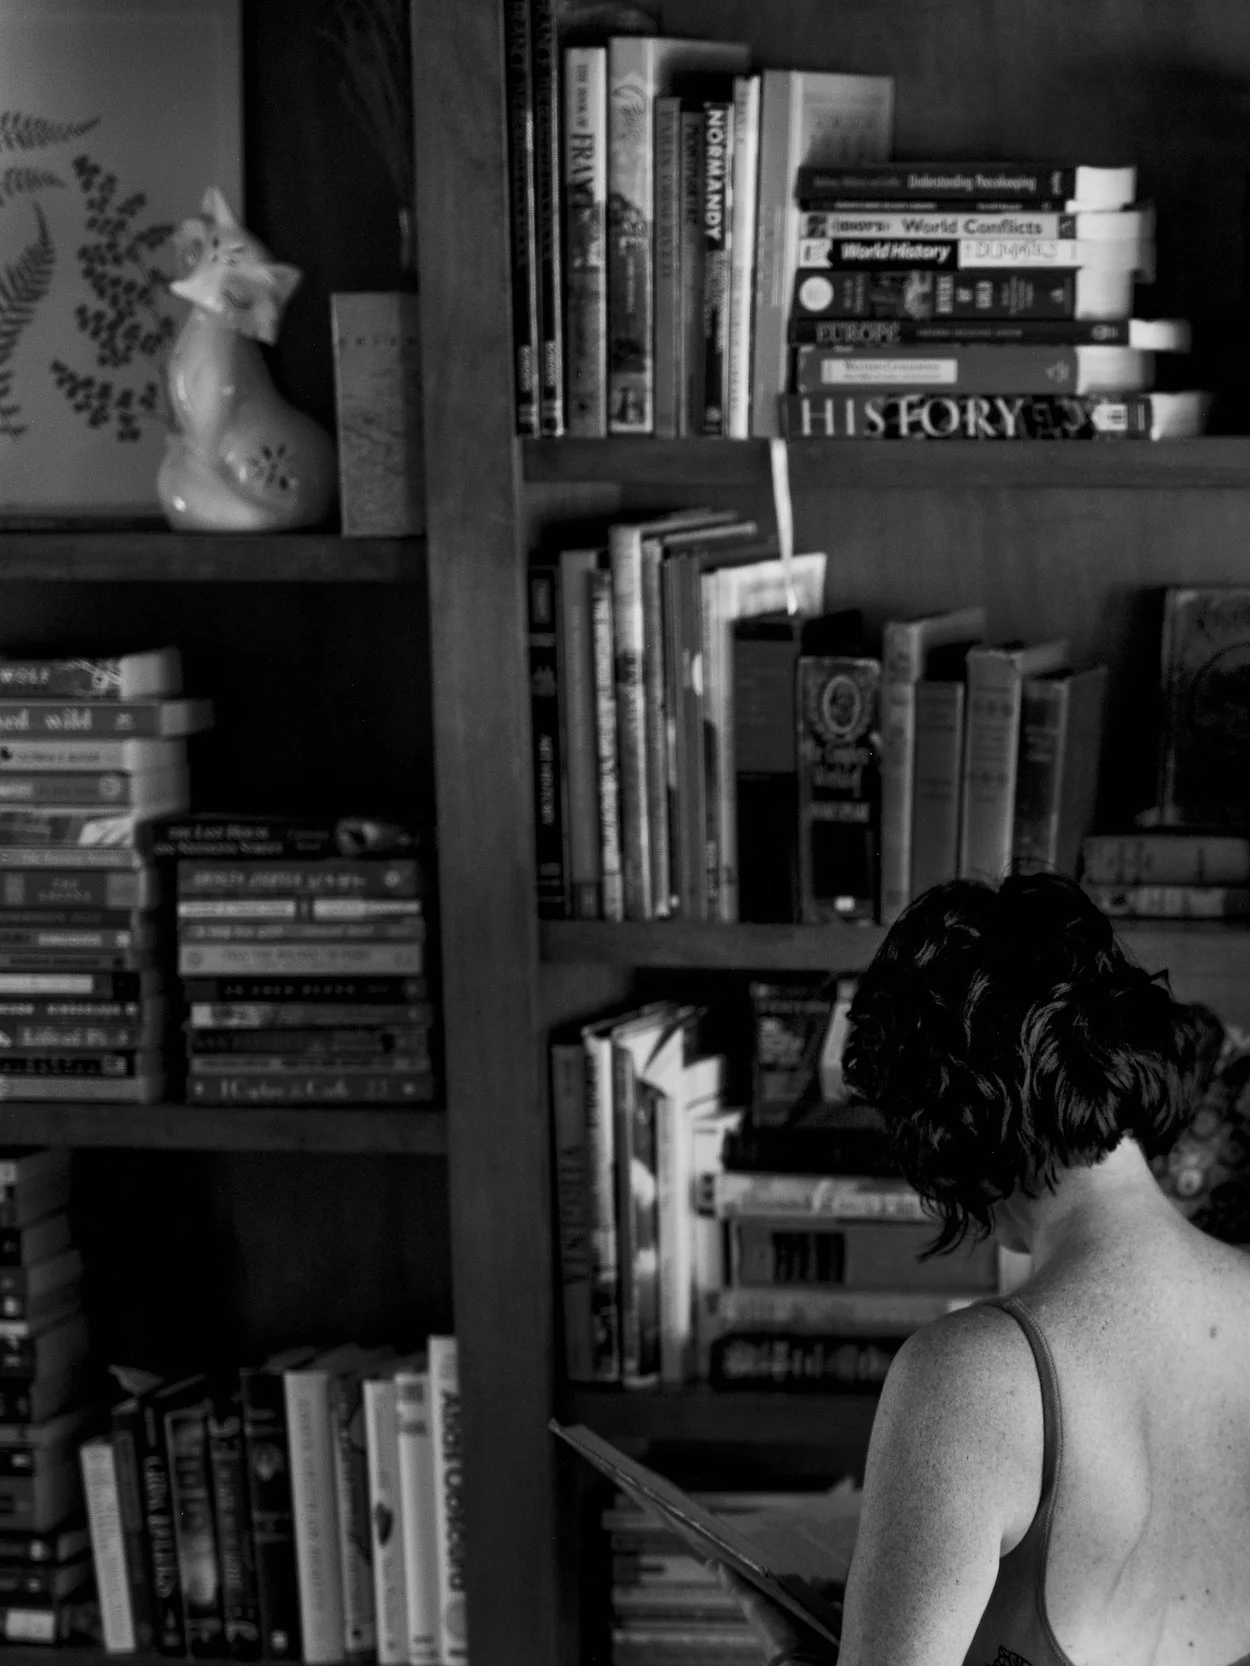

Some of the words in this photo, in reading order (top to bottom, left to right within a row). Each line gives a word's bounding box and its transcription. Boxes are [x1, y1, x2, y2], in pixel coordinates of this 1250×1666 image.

[704, 109, 723, 240] NORMANDY
[907, 175, 973, 191] Understanding
[976, 174, 1037, 191] Peacekeeping
[902, 218, 957, 234] World
[964, 218, 1042, 235] Conflicts
[841, 243, 888, 260] World
[890, 243, 951, 263] History
[816, 322, 901, 343] EUROPE
[801, 398, 1022, 436] HISTORY
